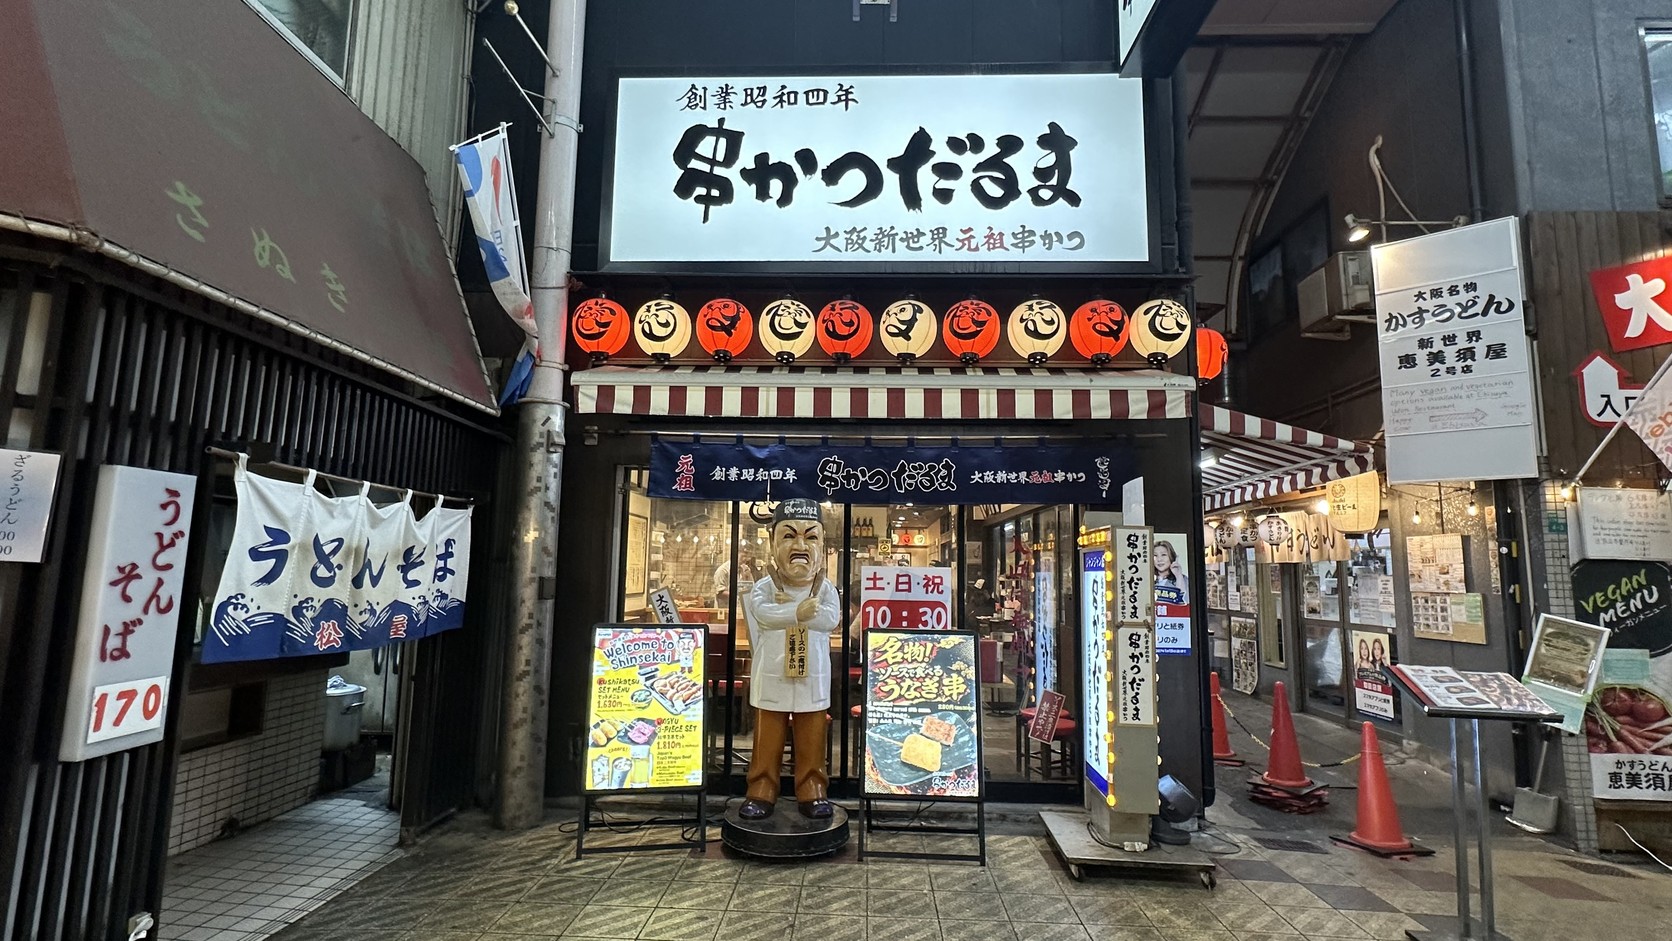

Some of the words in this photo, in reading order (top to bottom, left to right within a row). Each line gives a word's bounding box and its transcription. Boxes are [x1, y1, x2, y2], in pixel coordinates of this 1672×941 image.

[676, 83, 859, 111] 創業昭和四年
[673, 117, 1082, 224] 串かつだるま
[165, 180, 349, 314] さぬき
[811, 225, 1086, 254] 大阪新世界元祖串かつ
[1414, 281, 1478, 303] 大阪名物
[1614, 273, 1672, 339] 大
[1384, 294, 1515, 332] かすうどん
[1397, 343, 1508, 370] 恵美須屋
[1417, 330, 1483, 350] 新世界
[1430, 364, 1474, 377] 2号店
[672, 454, 696, 492] 元祖
[709, 465, 798, 484] 創業昭和四年
[816, 455, 957, 496] 串かつだるま
[969, 470, 1087, 485] 大阪新世界元祖串かつ
[1, 454, 31, 526] ざるうどん
[146, 487, 185, 615] うどん
[1126, 532, 1143, 620] 串かつだるま
[1580, 568, 1647, 614] VEGAN
[99, 562, 143, 662] そば
[1599, 585, 1659, 628] MENU
[603, 640, 658, 659] Welcome
[661, 639, 674, 650] to
[610, 651, 671, 670] Shinsekai
[878, 665, 944, 681] ソースで食べる
[880, 673, 968, 702] うなぎ串
[1128, 631, 1145, 721] 串かつだるま
[598, 686, 611, 694] SET
[612, 686, 630, 694] MENU
[92, 684, 162, 733] 170
[1615, 759, 1672, 773] かすうどん
